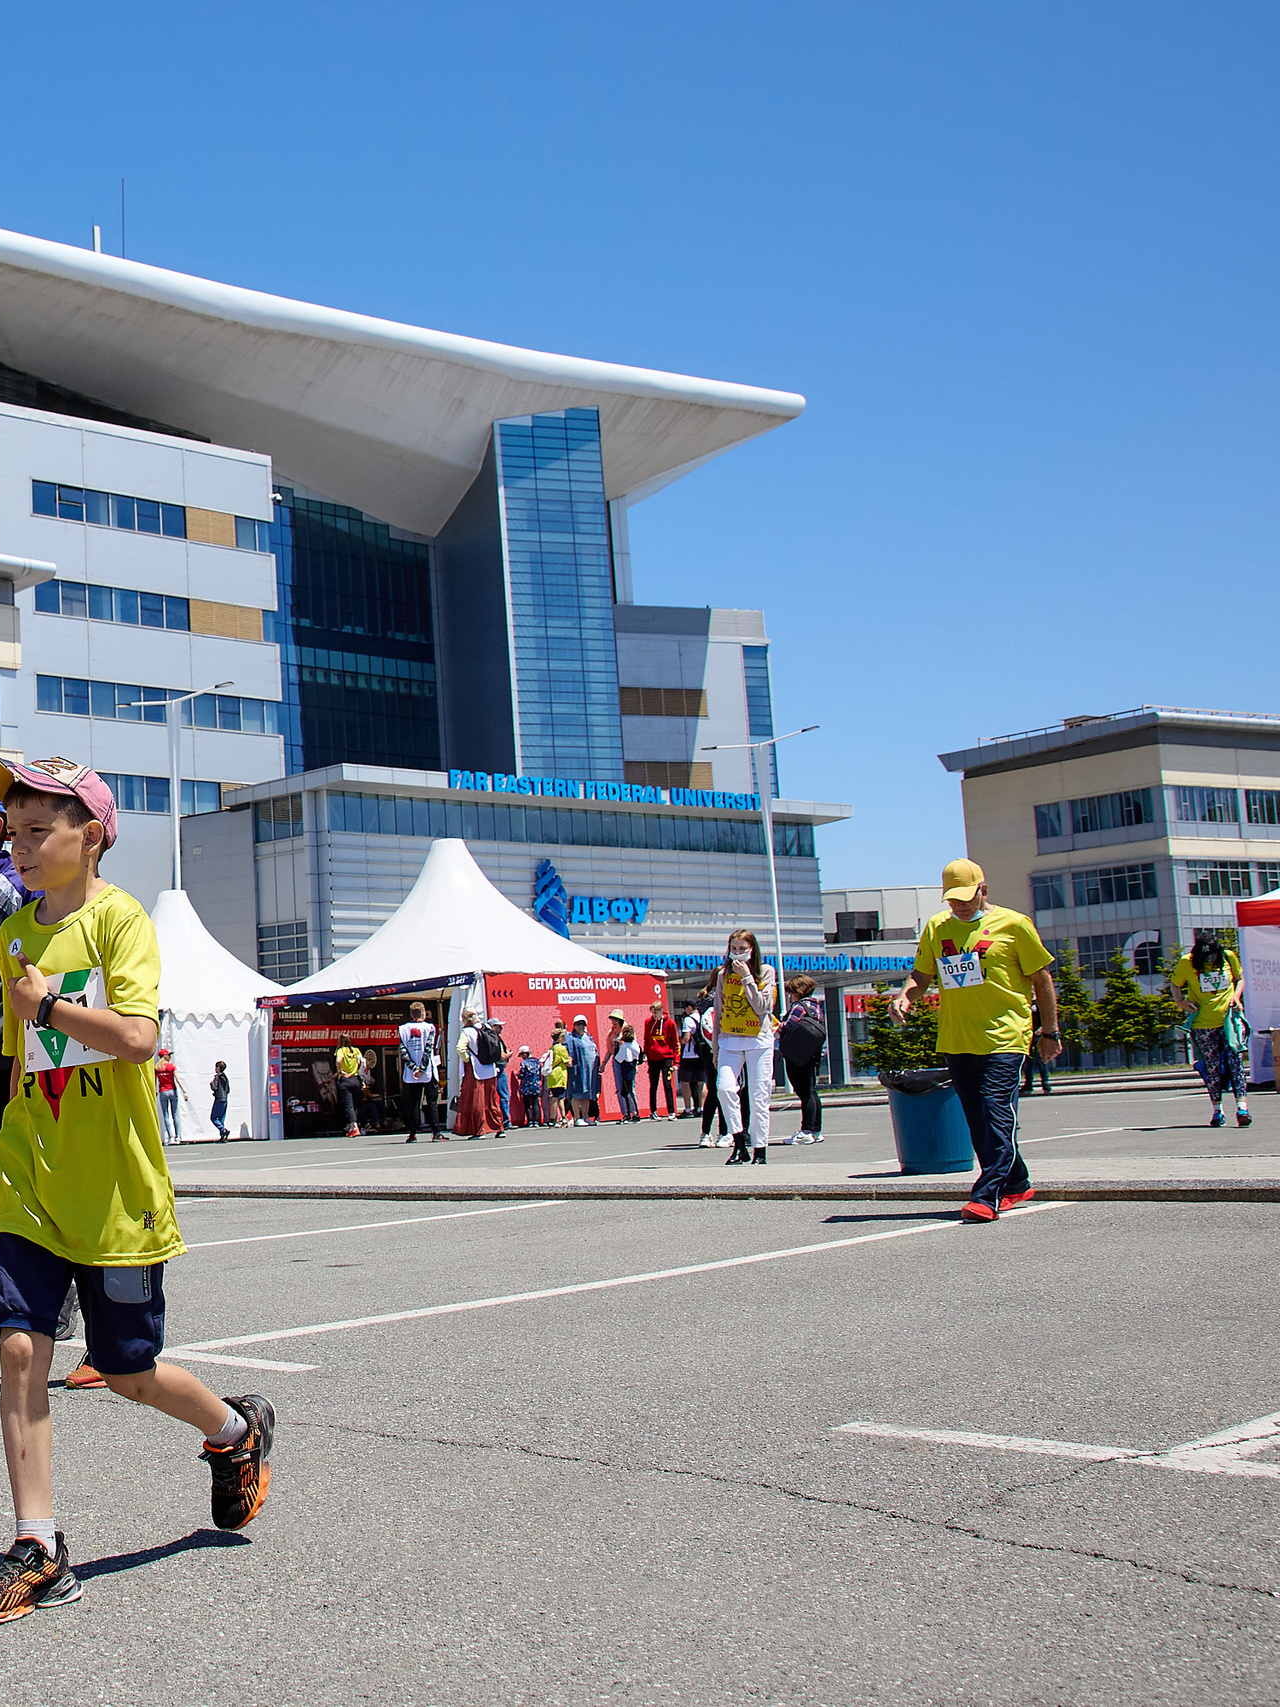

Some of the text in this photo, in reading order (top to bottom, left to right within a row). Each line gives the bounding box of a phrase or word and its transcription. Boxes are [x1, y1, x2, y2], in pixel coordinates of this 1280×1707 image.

[448, 769, 761, 811] FAR EASTERN FEDERAL UNIVERSIT
[570, 895, 650, 924] ДВФУ
[11, 941, 19, 953] A
[600, 953, 915, 971] ЛЬНЕВОСТОЧН ДРАЛЬНЫЙ УНИВЕРС
[942, 961, 975, 975] 10160
[528, 975, 627, 992] БЕГИ ЗА СВОЙ ГОРОД
[50, 1035, 58, 1051] 1
